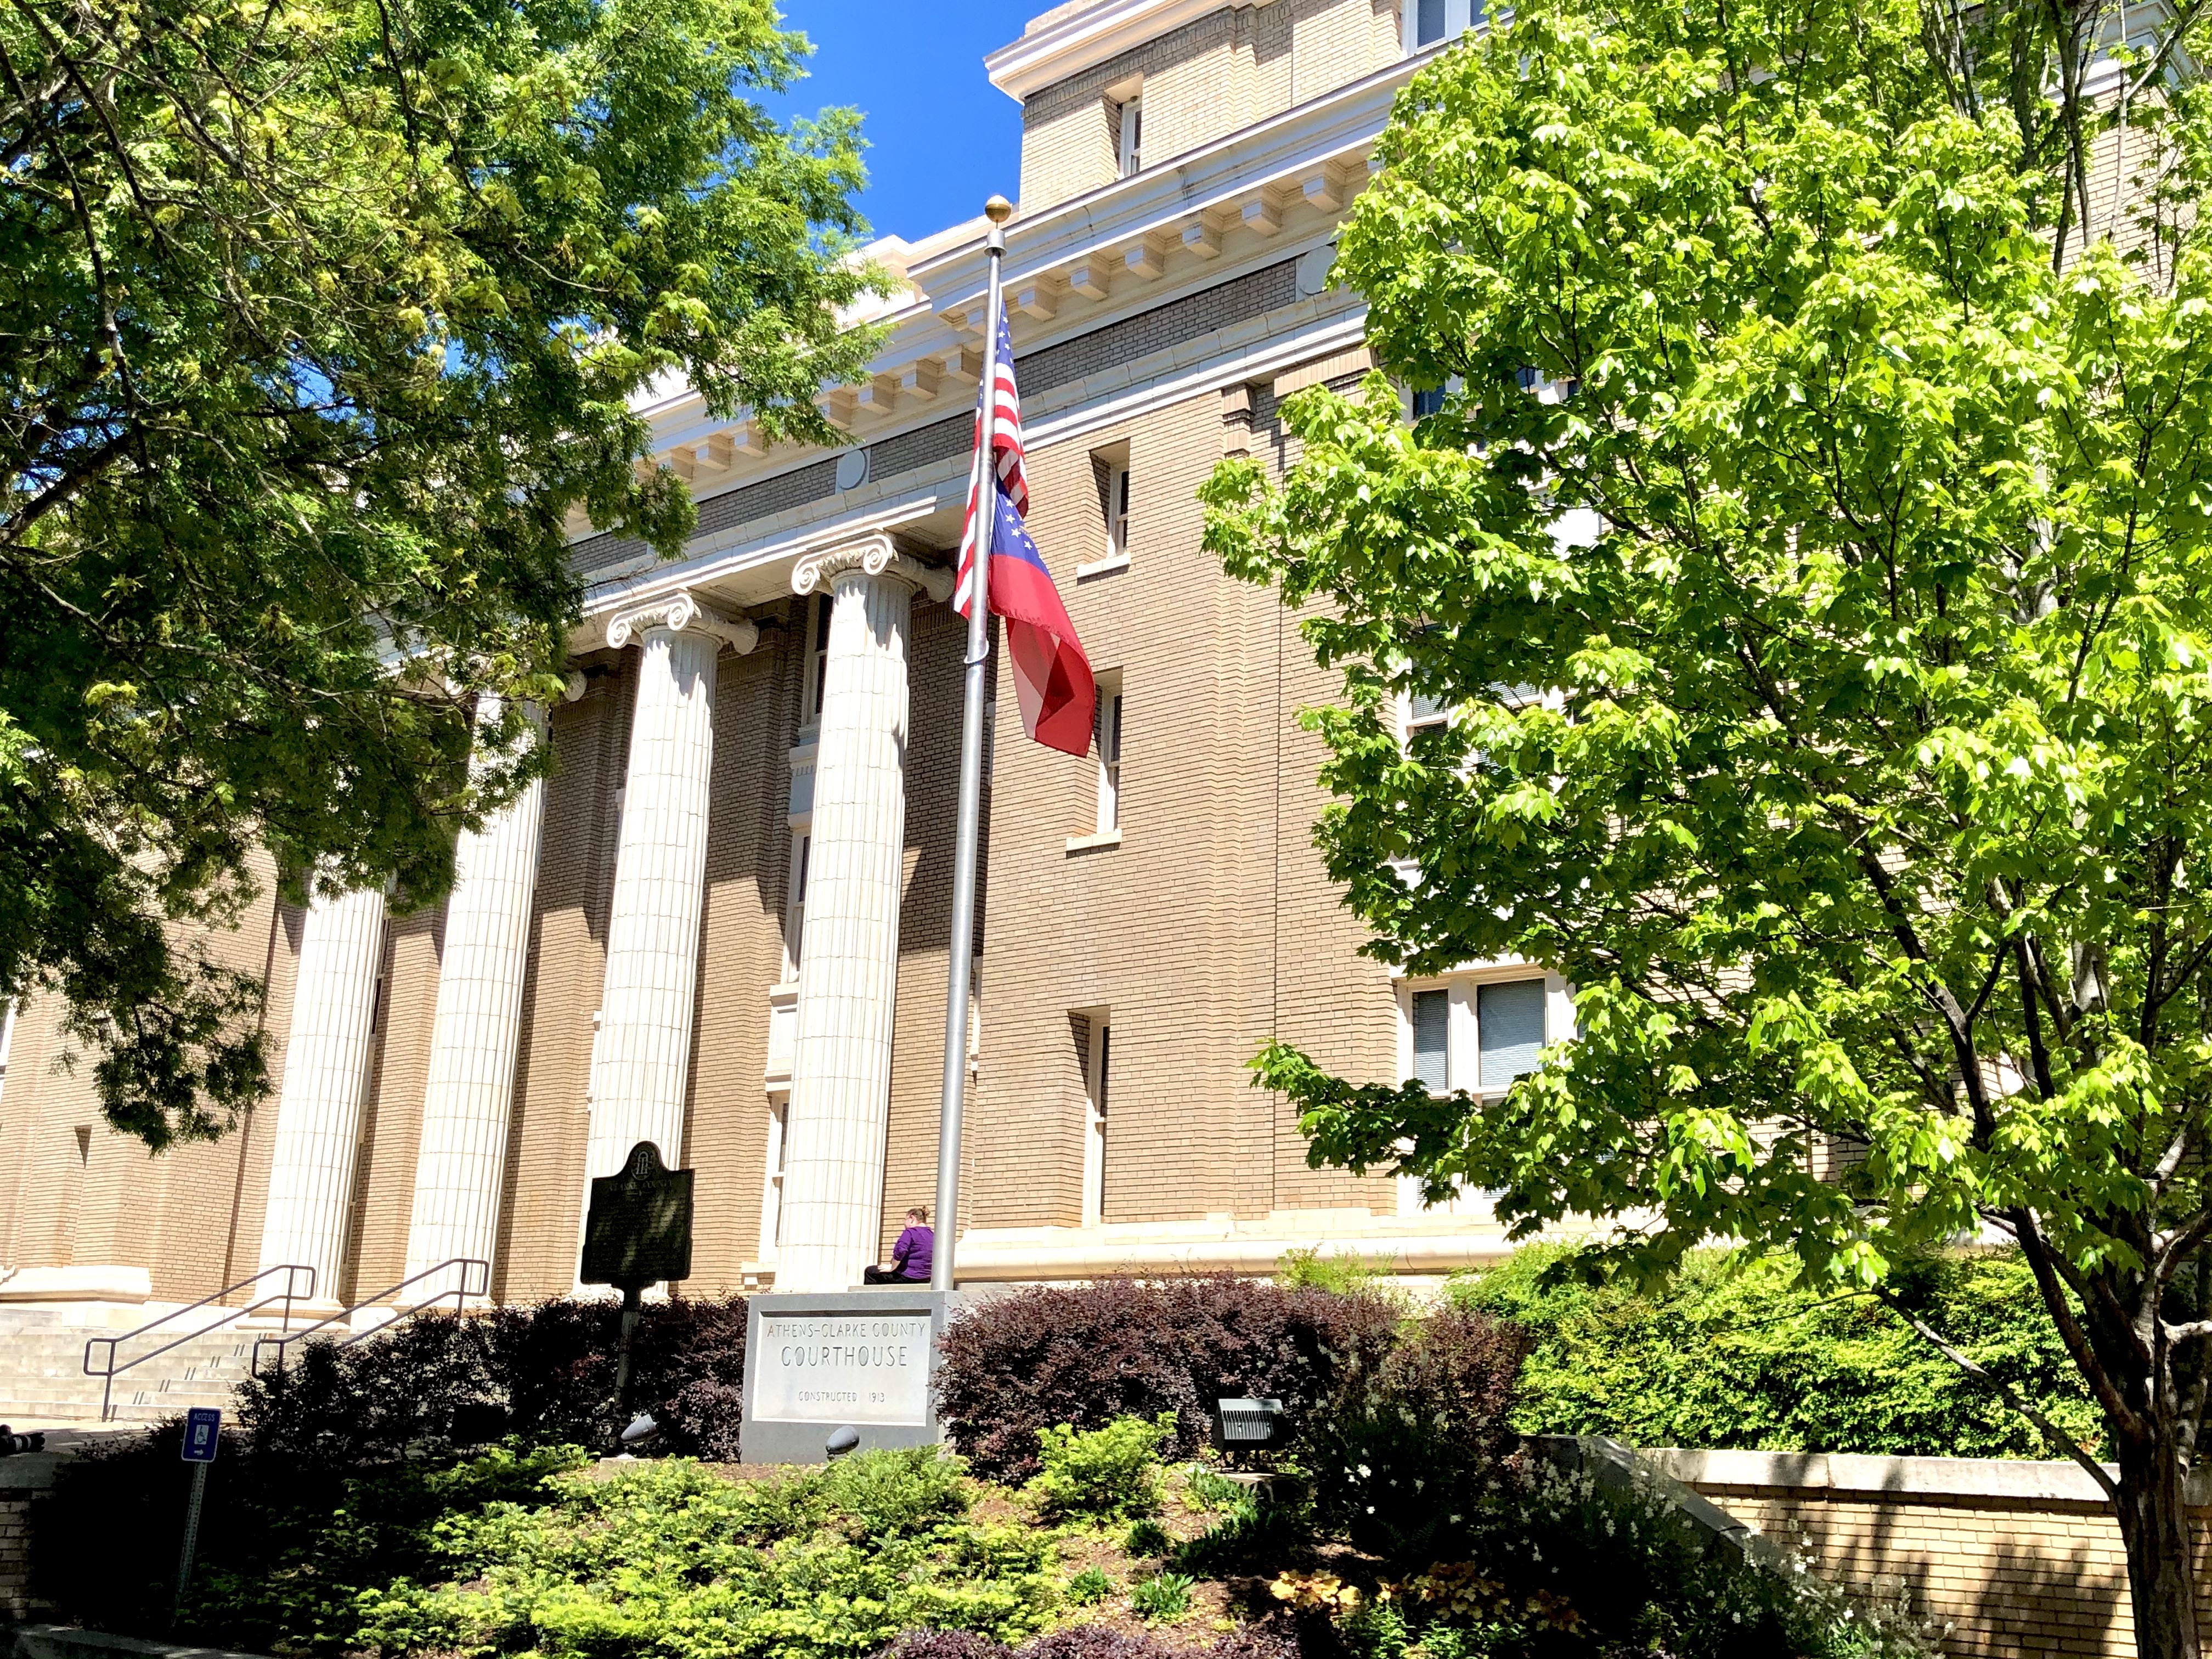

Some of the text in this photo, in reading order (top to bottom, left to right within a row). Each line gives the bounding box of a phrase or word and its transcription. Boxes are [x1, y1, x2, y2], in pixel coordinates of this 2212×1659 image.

[767, 1323, 926, 1338] ATHENS-CLARKE COUNTY
[781, 1346, 907, 1367] COURTHOUSE
[799, 1391, 885, 1403] CONSTRUCTED 1913
[193, 1413, 215, 1422] ACCESS
